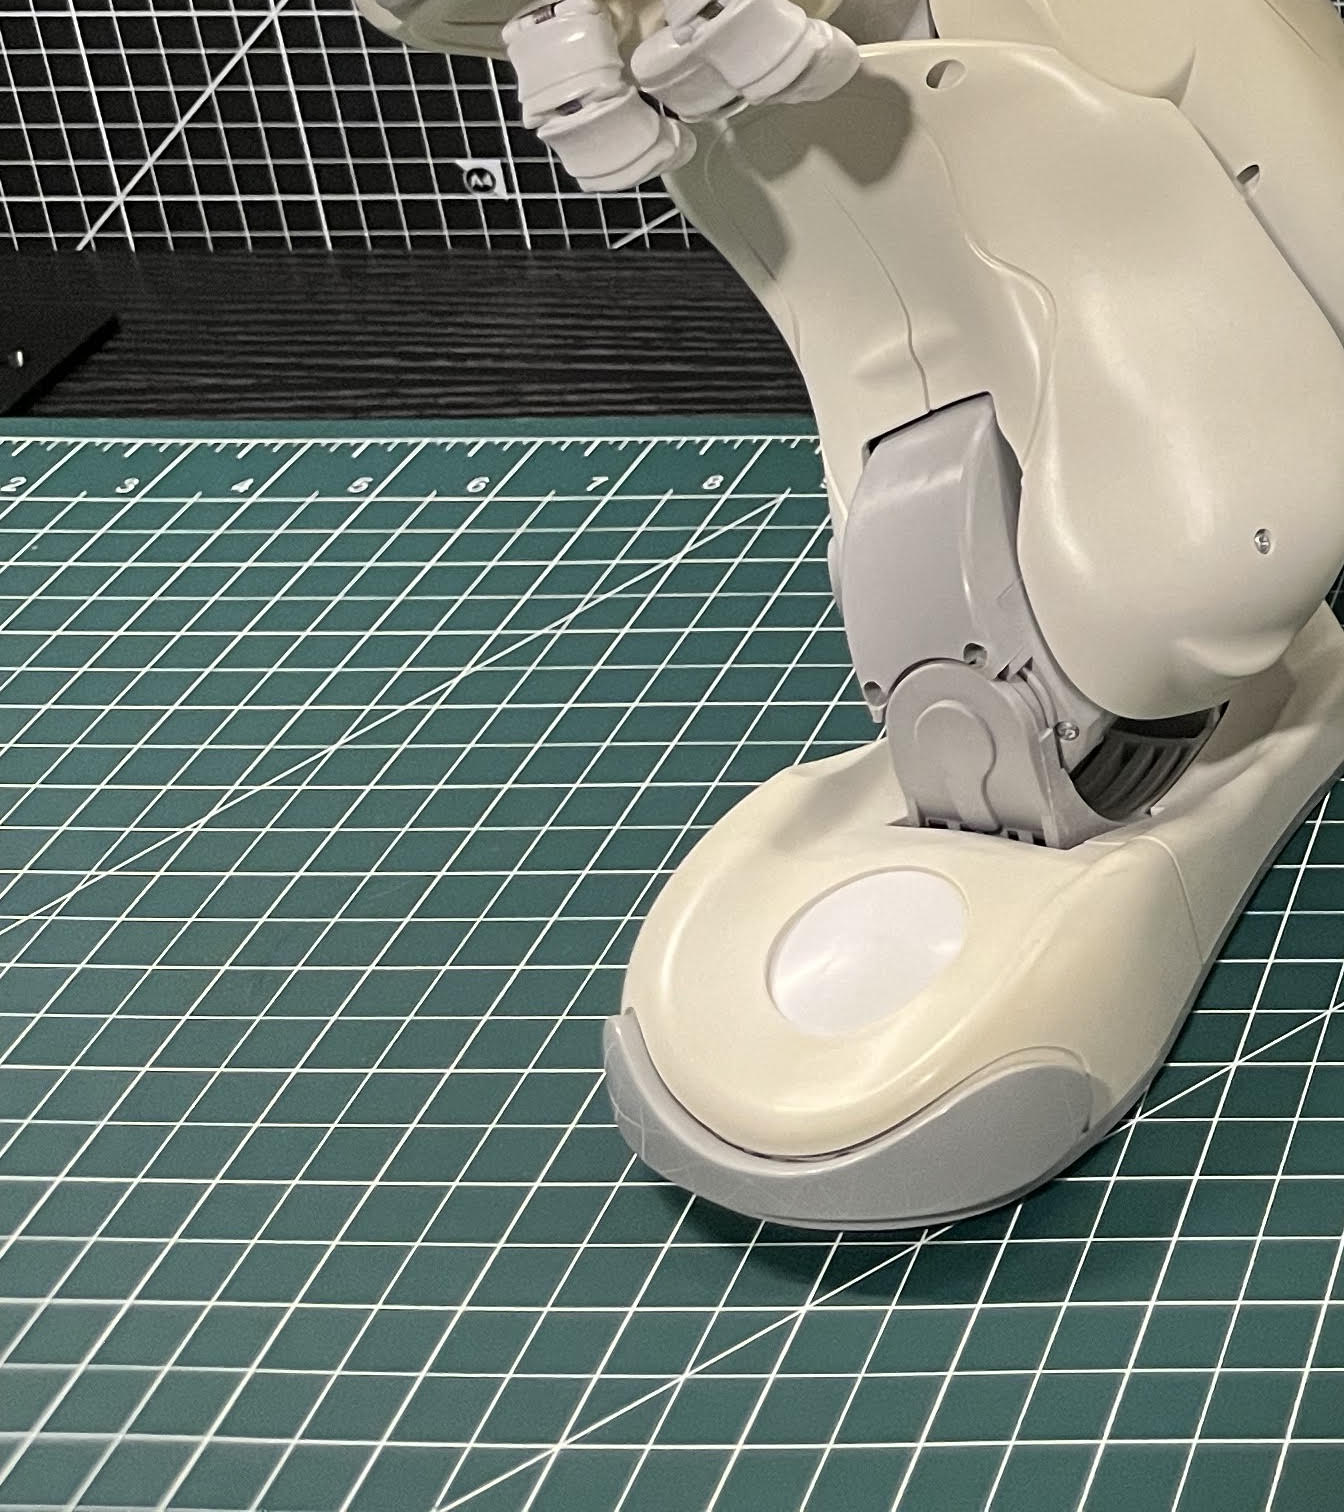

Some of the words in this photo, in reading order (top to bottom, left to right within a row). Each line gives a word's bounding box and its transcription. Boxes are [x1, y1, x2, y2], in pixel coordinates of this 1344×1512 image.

[0, 476, 27, 493] 2
[115, 477, 140, 494] 3
[231, 478, 254, 493] 4
[347, 476, 374, 494] 5
[466, 476, 490, 493] 6
[586, 476, 609, 492] 7
[702, 474, 724, 490] 8
